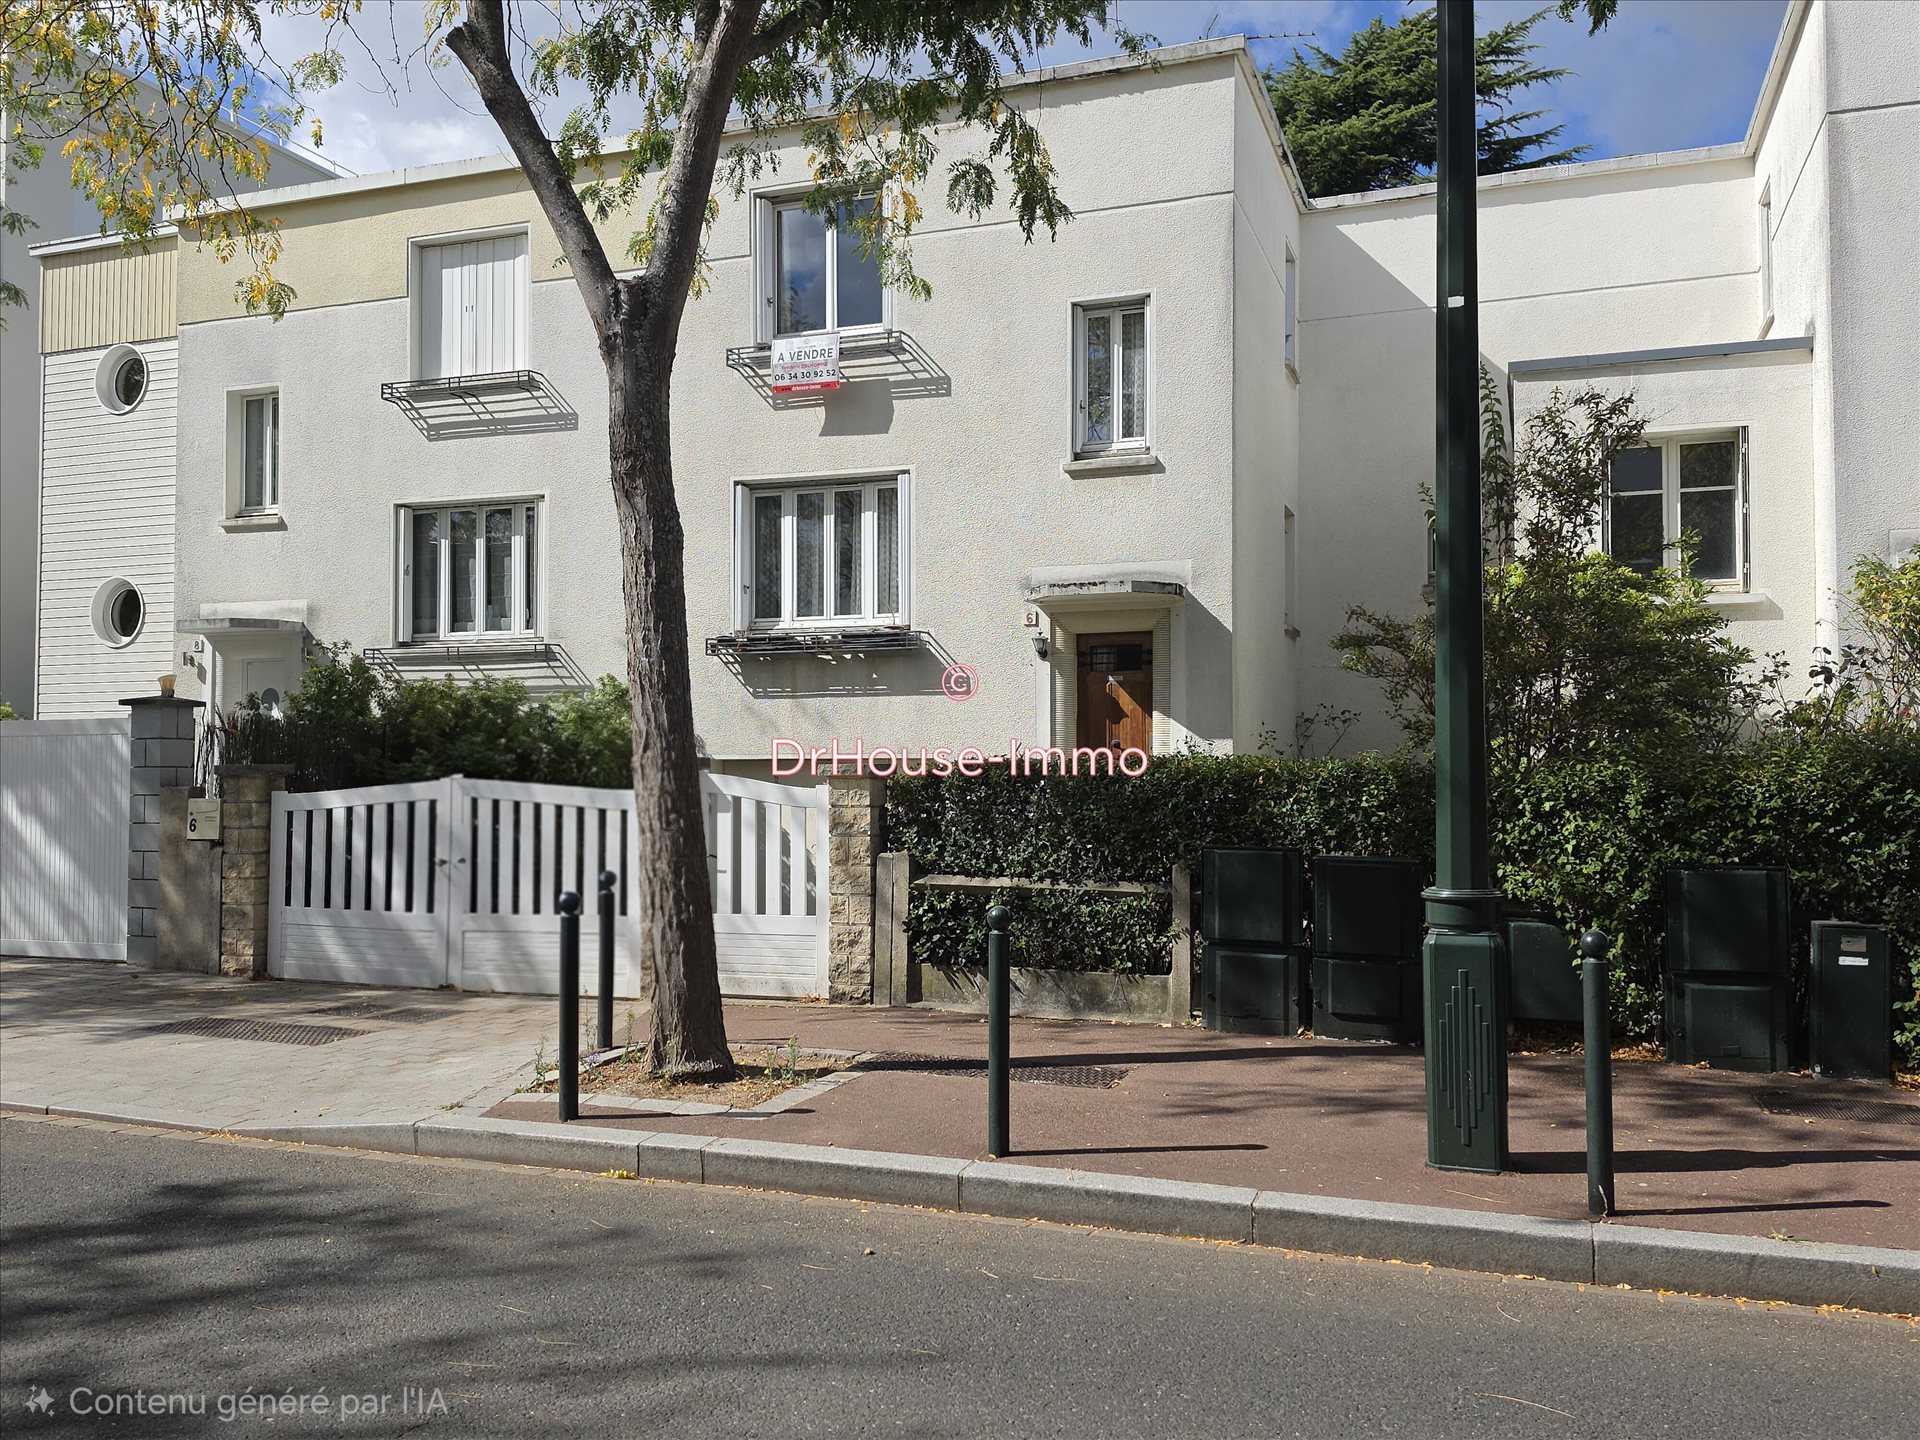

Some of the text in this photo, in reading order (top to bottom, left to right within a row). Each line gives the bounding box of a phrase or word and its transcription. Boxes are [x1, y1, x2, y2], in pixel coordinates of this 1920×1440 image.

[777, 348, 833, 362] A VENDRE
[774, 369, 836, 381] 06 34 30 92 52
[1026, 612, 1033, 623] 6
[194, 640, 200, 650] 8
[189, 818, 197, 832] 6
